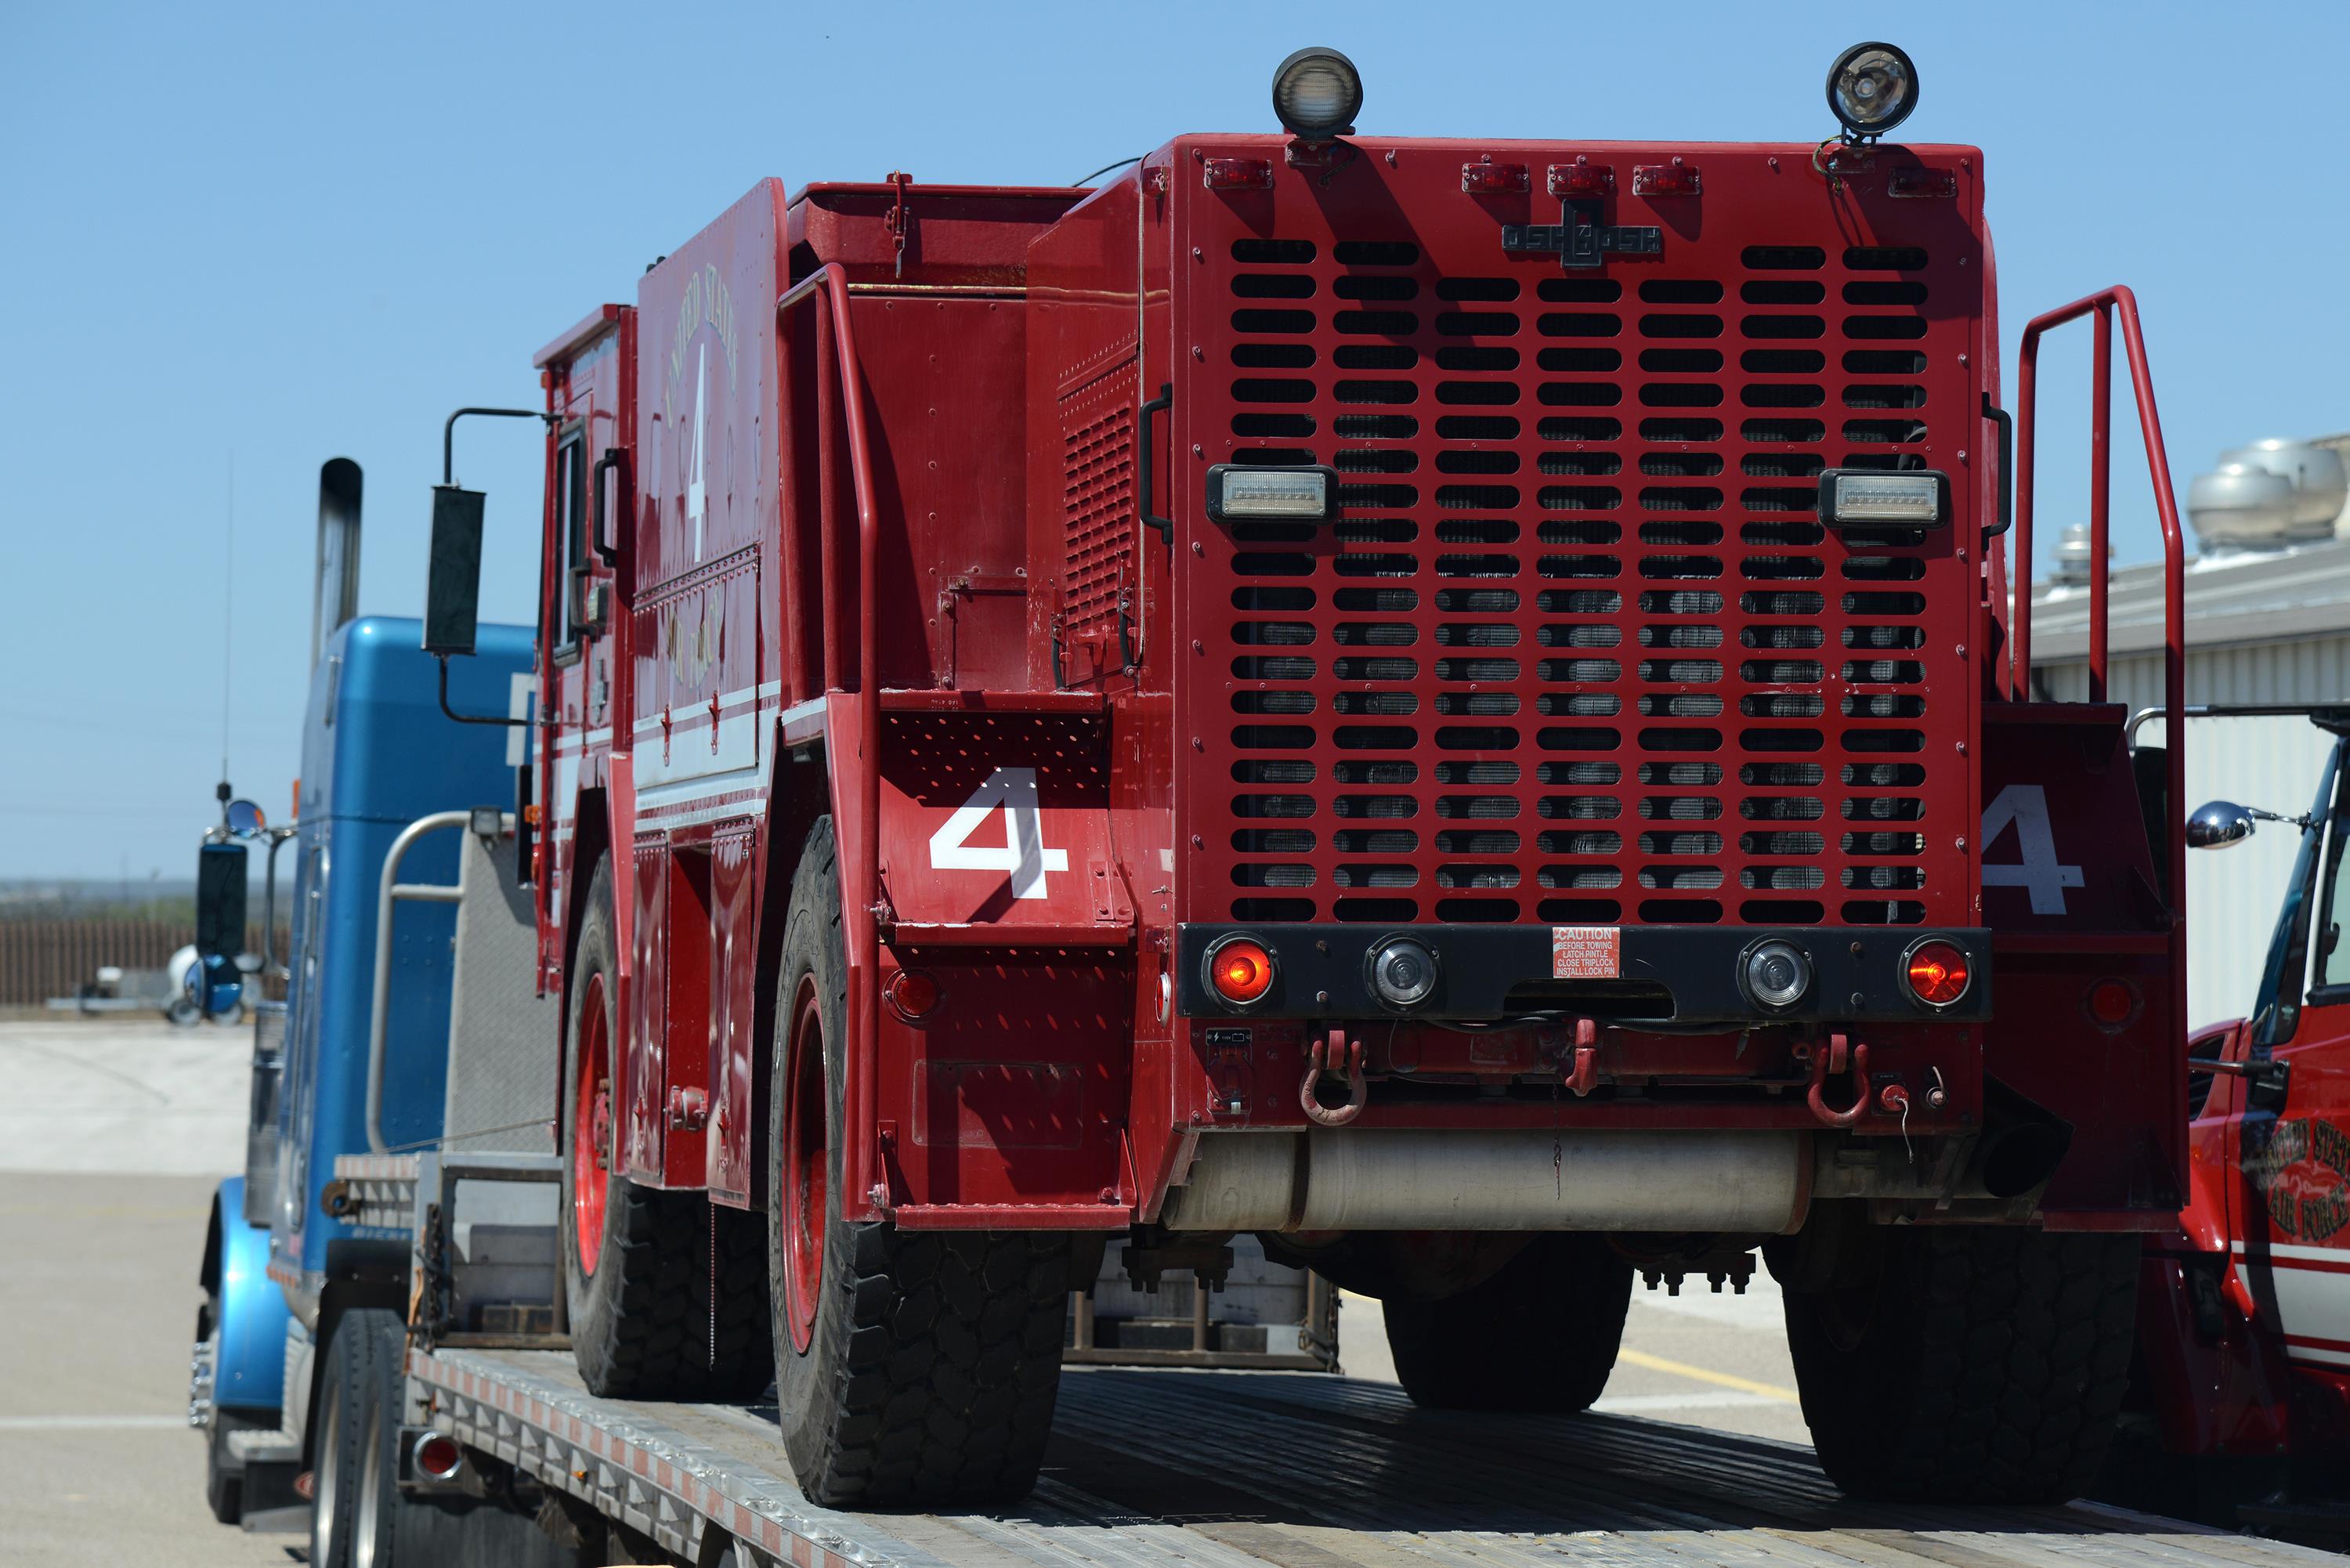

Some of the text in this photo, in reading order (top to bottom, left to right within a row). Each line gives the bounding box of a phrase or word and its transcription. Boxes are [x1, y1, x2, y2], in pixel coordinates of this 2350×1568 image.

[689, 343, 704, 564] 4
[929, 767, 1068, 899] 4
[1981, 785, 2085, 915] 4
[1559, 928, 1612, 940] CAUTION
[1559, 941, 1612, 949] BEFORE TOWING
[1556, 967, 1583, 976] INSTALL
[1603, 966, 1615, 975] PIN
[1563, 949, 1608, 958] LATCH PINTLE
[2270, 1182, 2348, 1241] AIR FORCE
